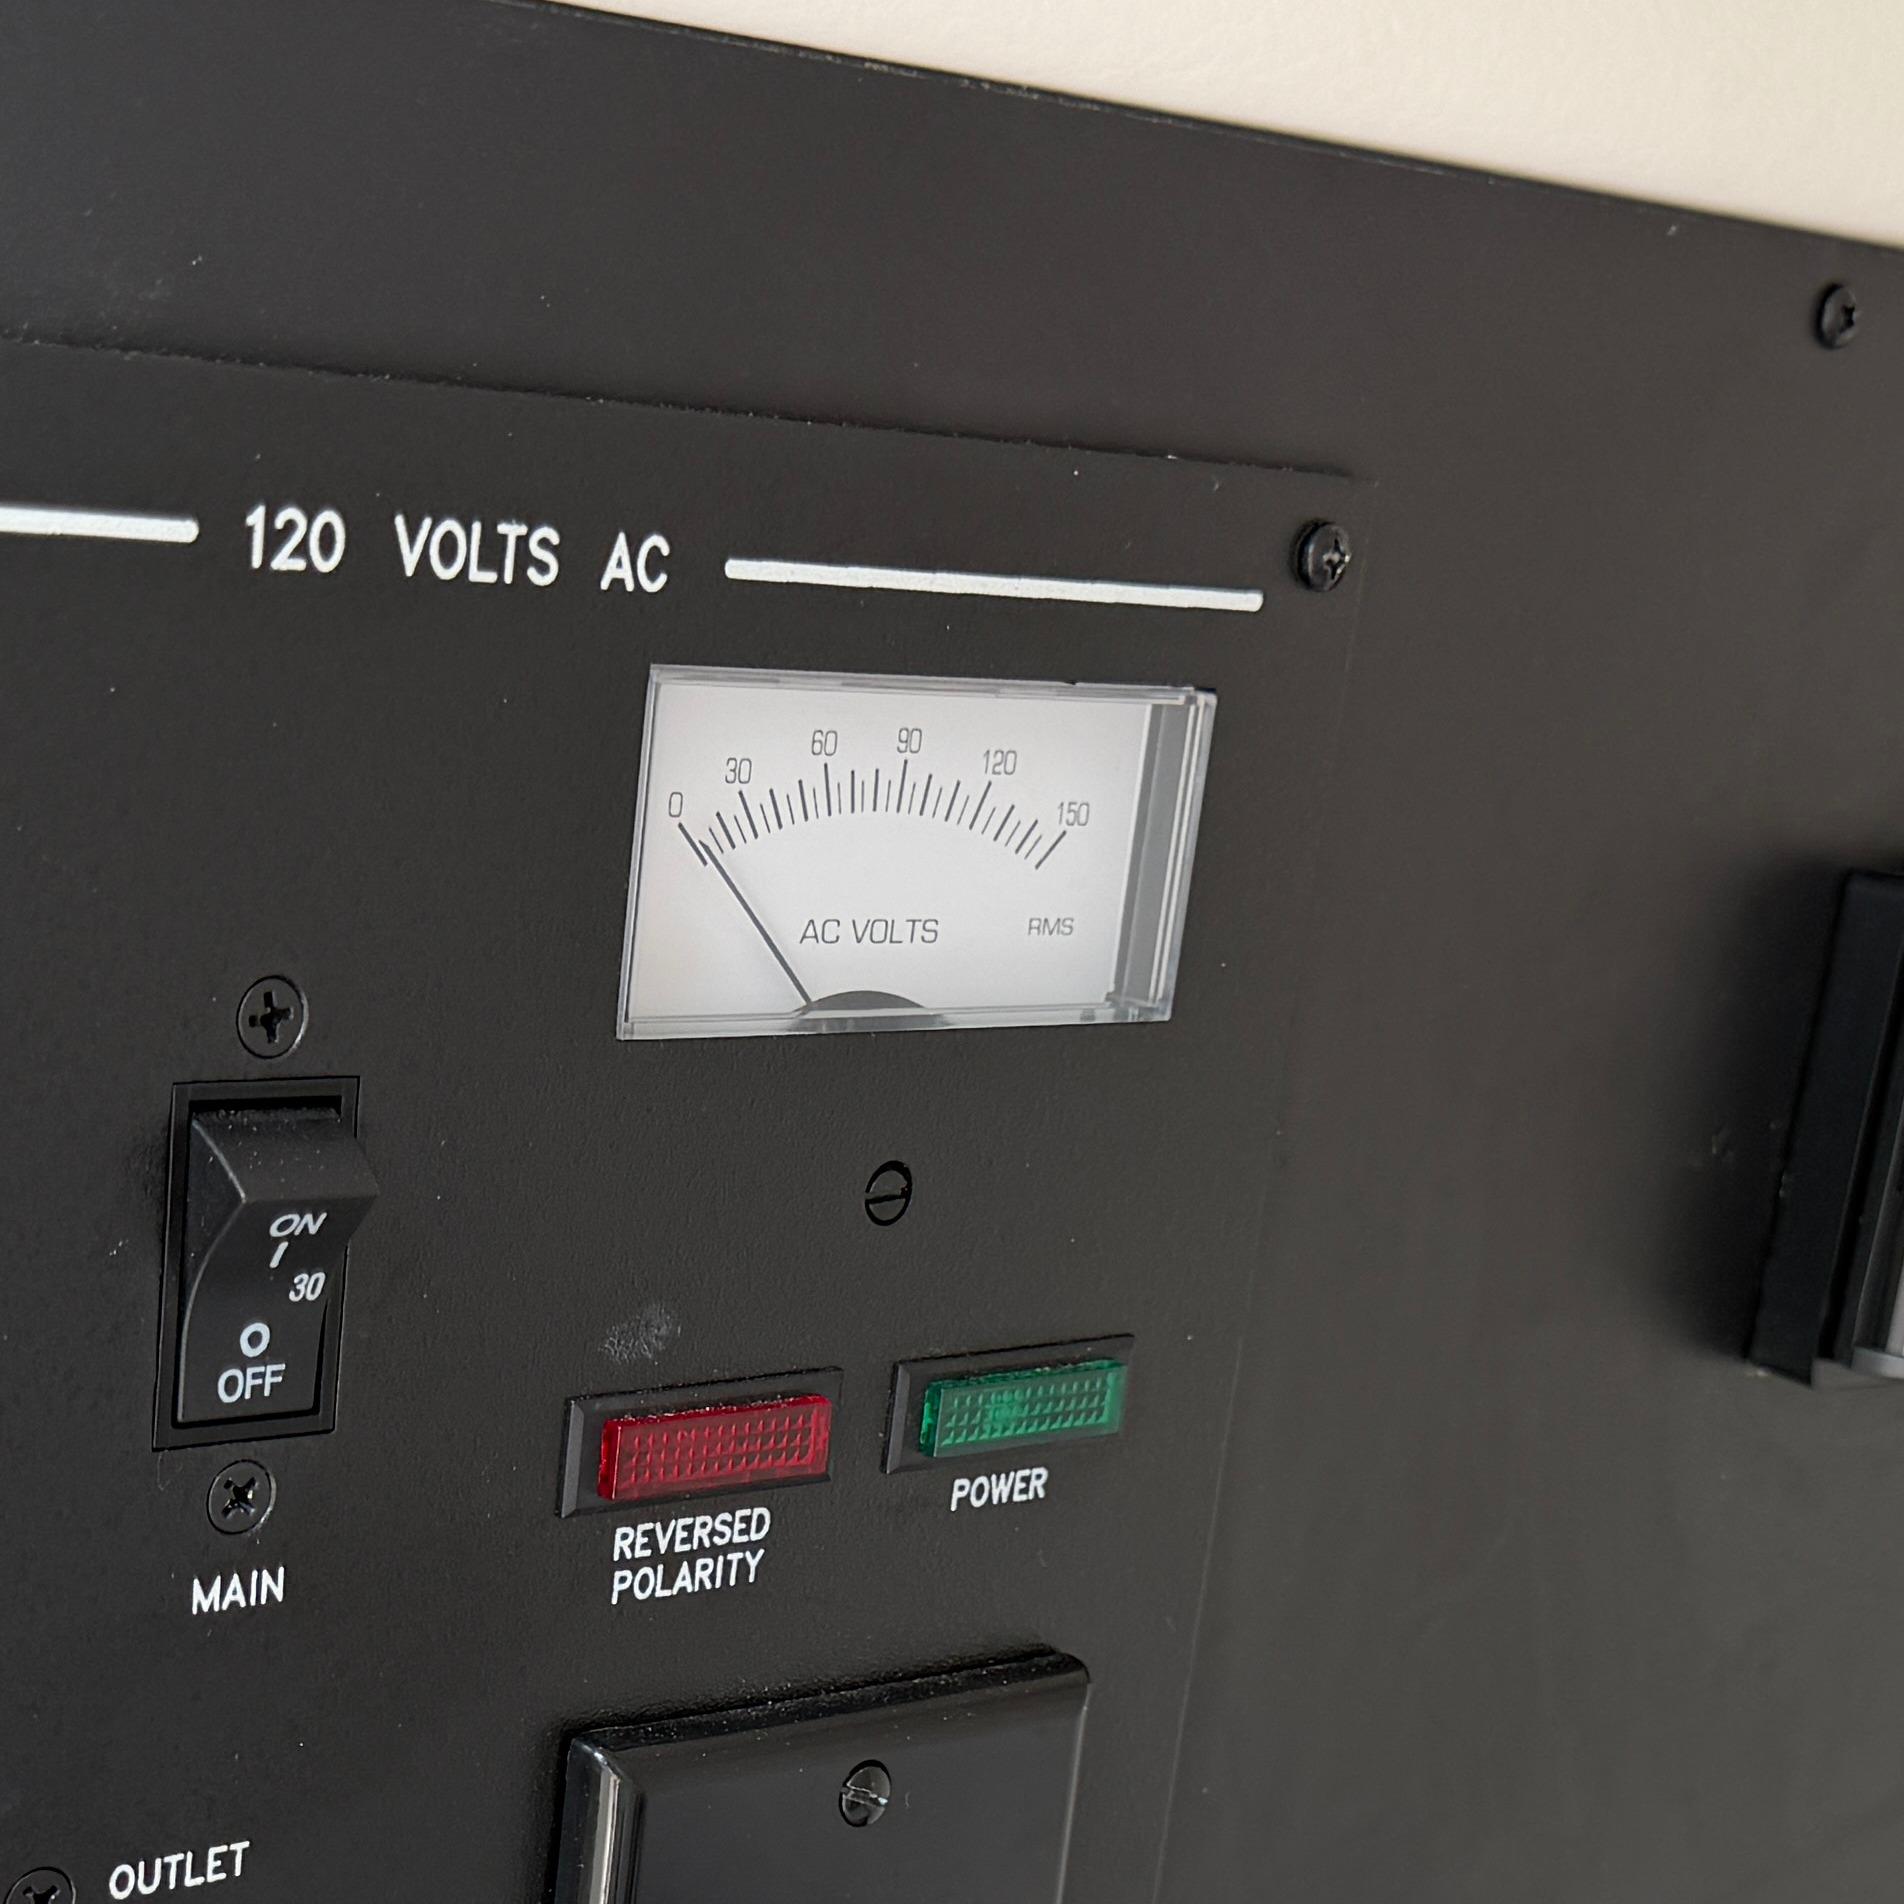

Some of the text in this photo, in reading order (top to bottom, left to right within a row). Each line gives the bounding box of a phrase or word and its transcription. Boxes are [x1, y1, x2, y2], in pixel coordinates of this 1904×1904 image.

[245, 504, 670, 593] 120 VOLTS AC
[668, 727, 1091, 827] 0 30 60 90 120 150
[799, 918, 939, 945] AC VOLTS
[1027, 917, 1075, 937] RMS
[269, 1212, 328, 1238] ON
[288, 1271, 326, 1302] 30
[217, 1363, 286, 1403] OFF
[950, 1466, 1049, 1512] POWER
[612, 1506, 772, 1562] REVERSED
[191, 1566, 285, 1615] MAIN
[610, 1548, 766, 1606] POLARITY
[108, 1840, 250, 1900] OUTLET
